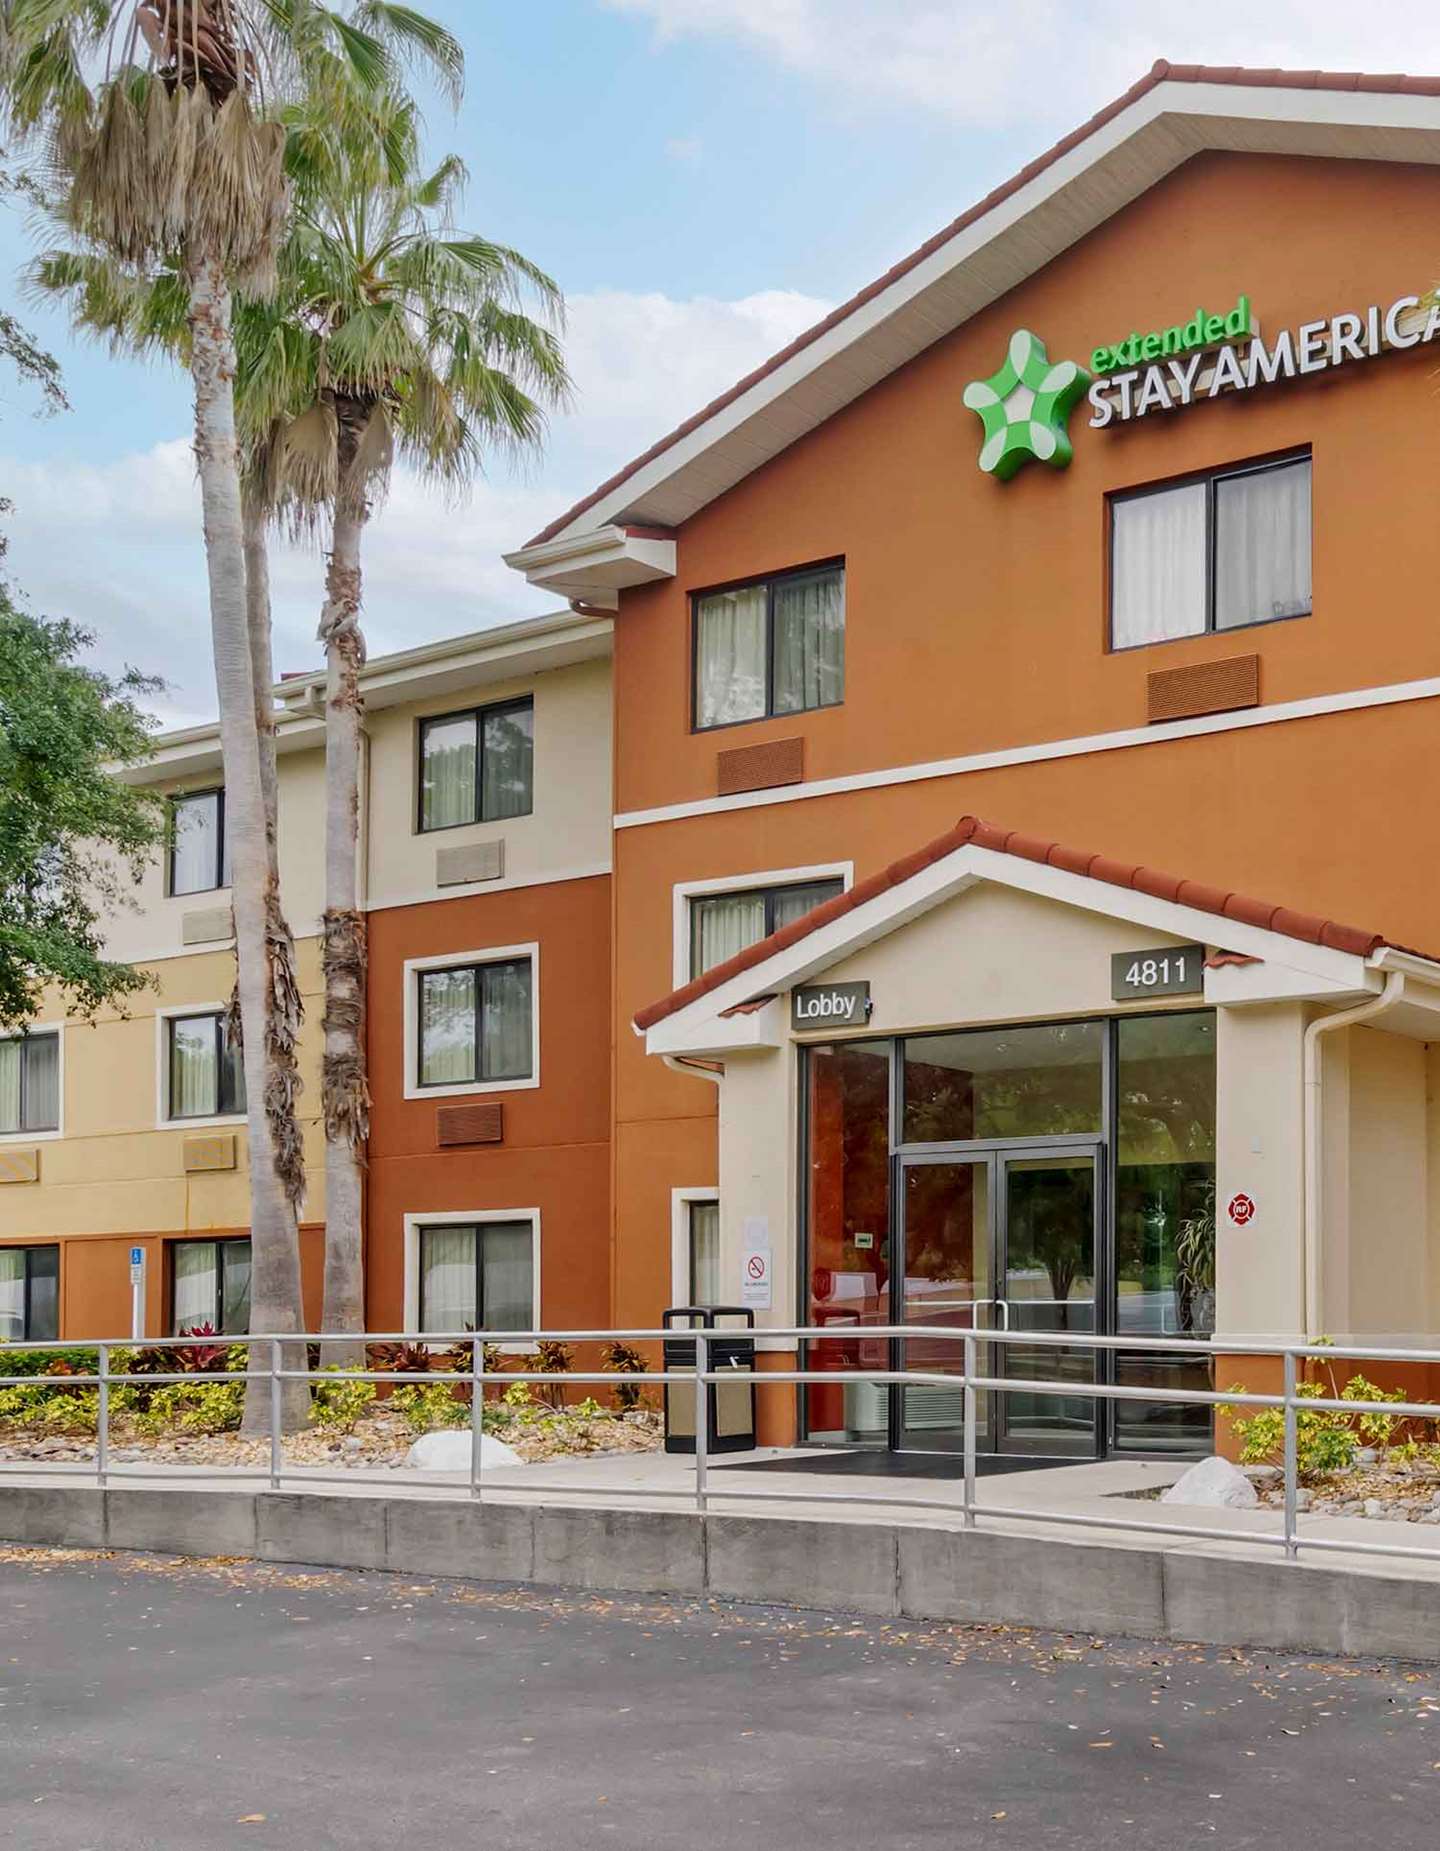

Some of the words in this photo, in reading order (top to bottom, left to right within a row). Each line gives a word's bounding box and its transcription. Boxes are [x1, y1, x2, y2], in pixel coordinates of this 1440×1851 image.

[1089, 294, 1251, 375] extended
[1125, 956, 1186, 987] 4811
[797, 991, 856, 1019] Lobby
